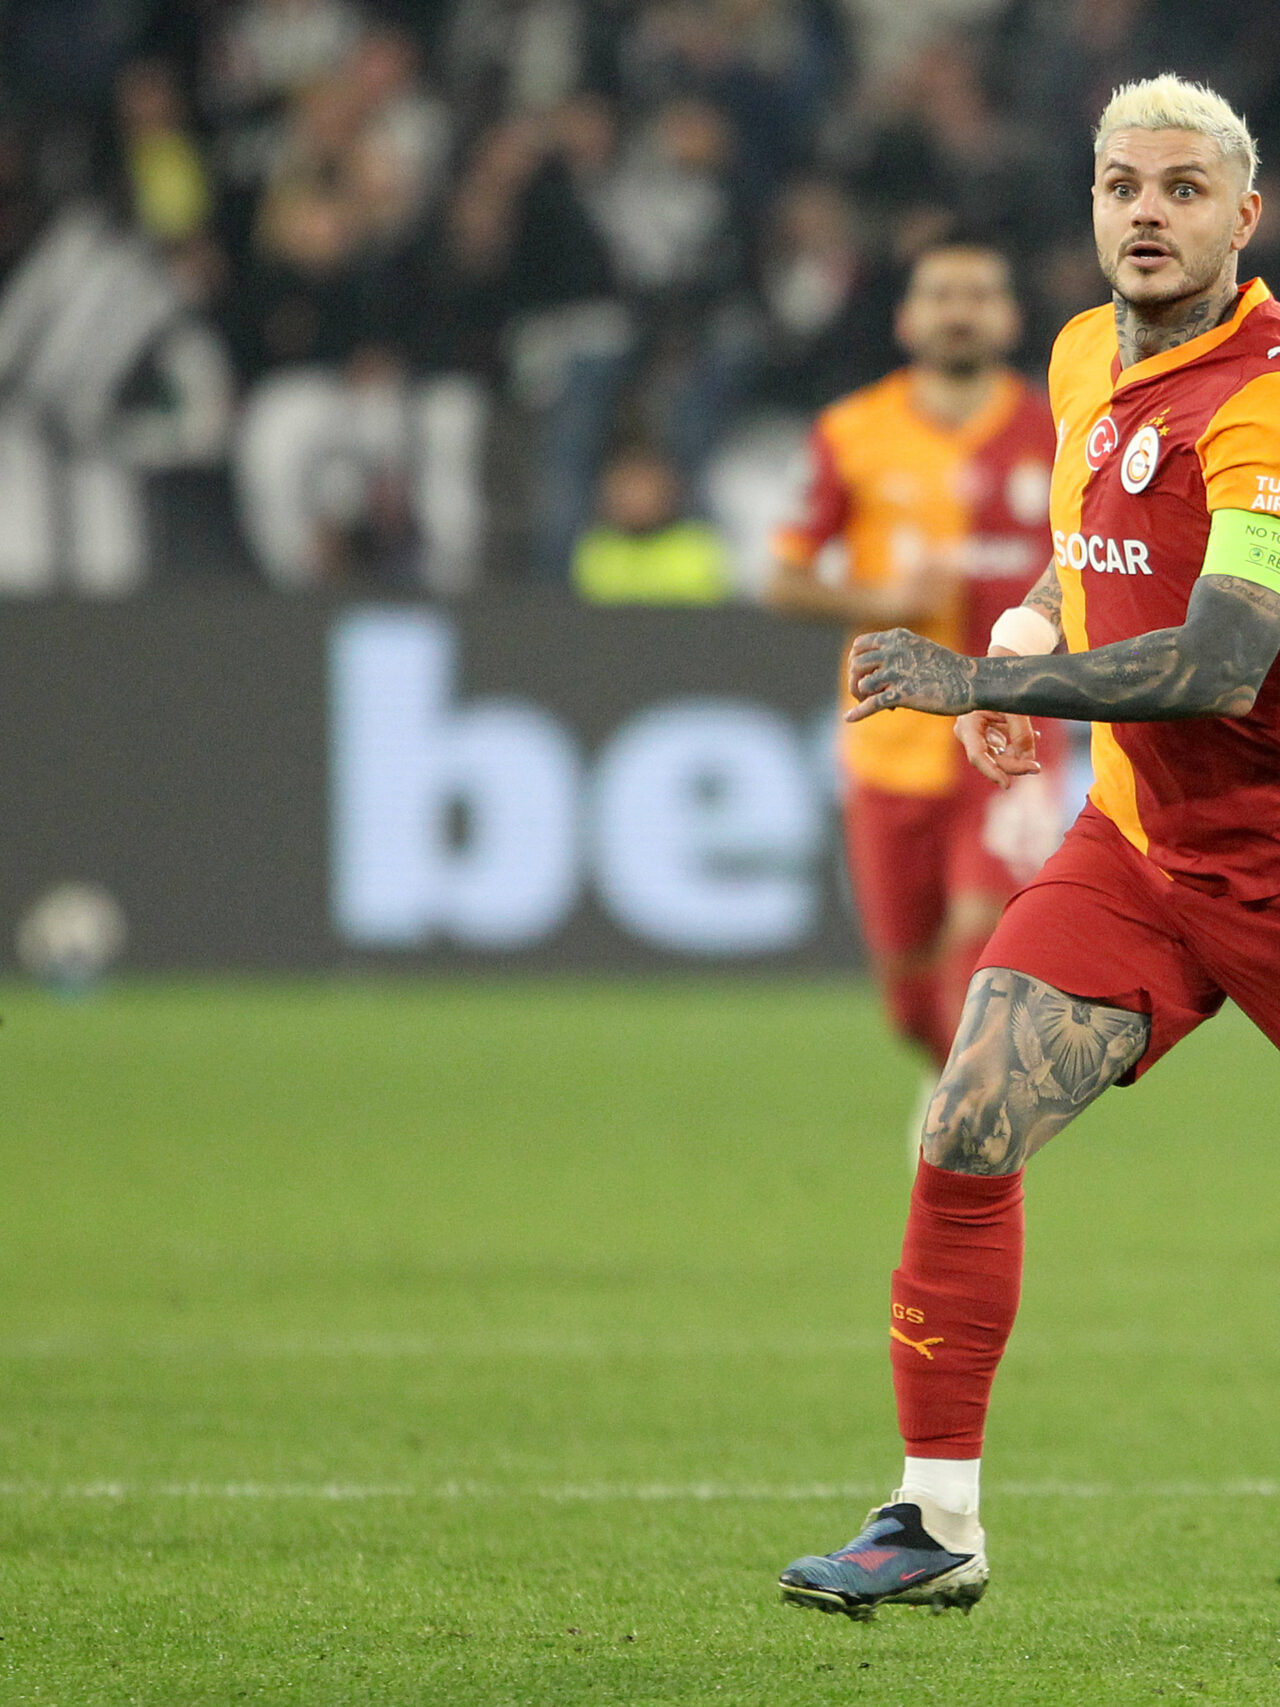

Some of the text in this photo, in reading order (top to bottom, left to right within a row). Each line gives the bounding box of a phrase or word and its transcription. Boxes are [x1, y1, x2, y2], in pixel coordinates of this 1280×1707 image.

[1245, 525, 1267, 538] NO
[1053, 530, 1154, 575] SOCAR
[892, 1303, 925, 1325] GS
